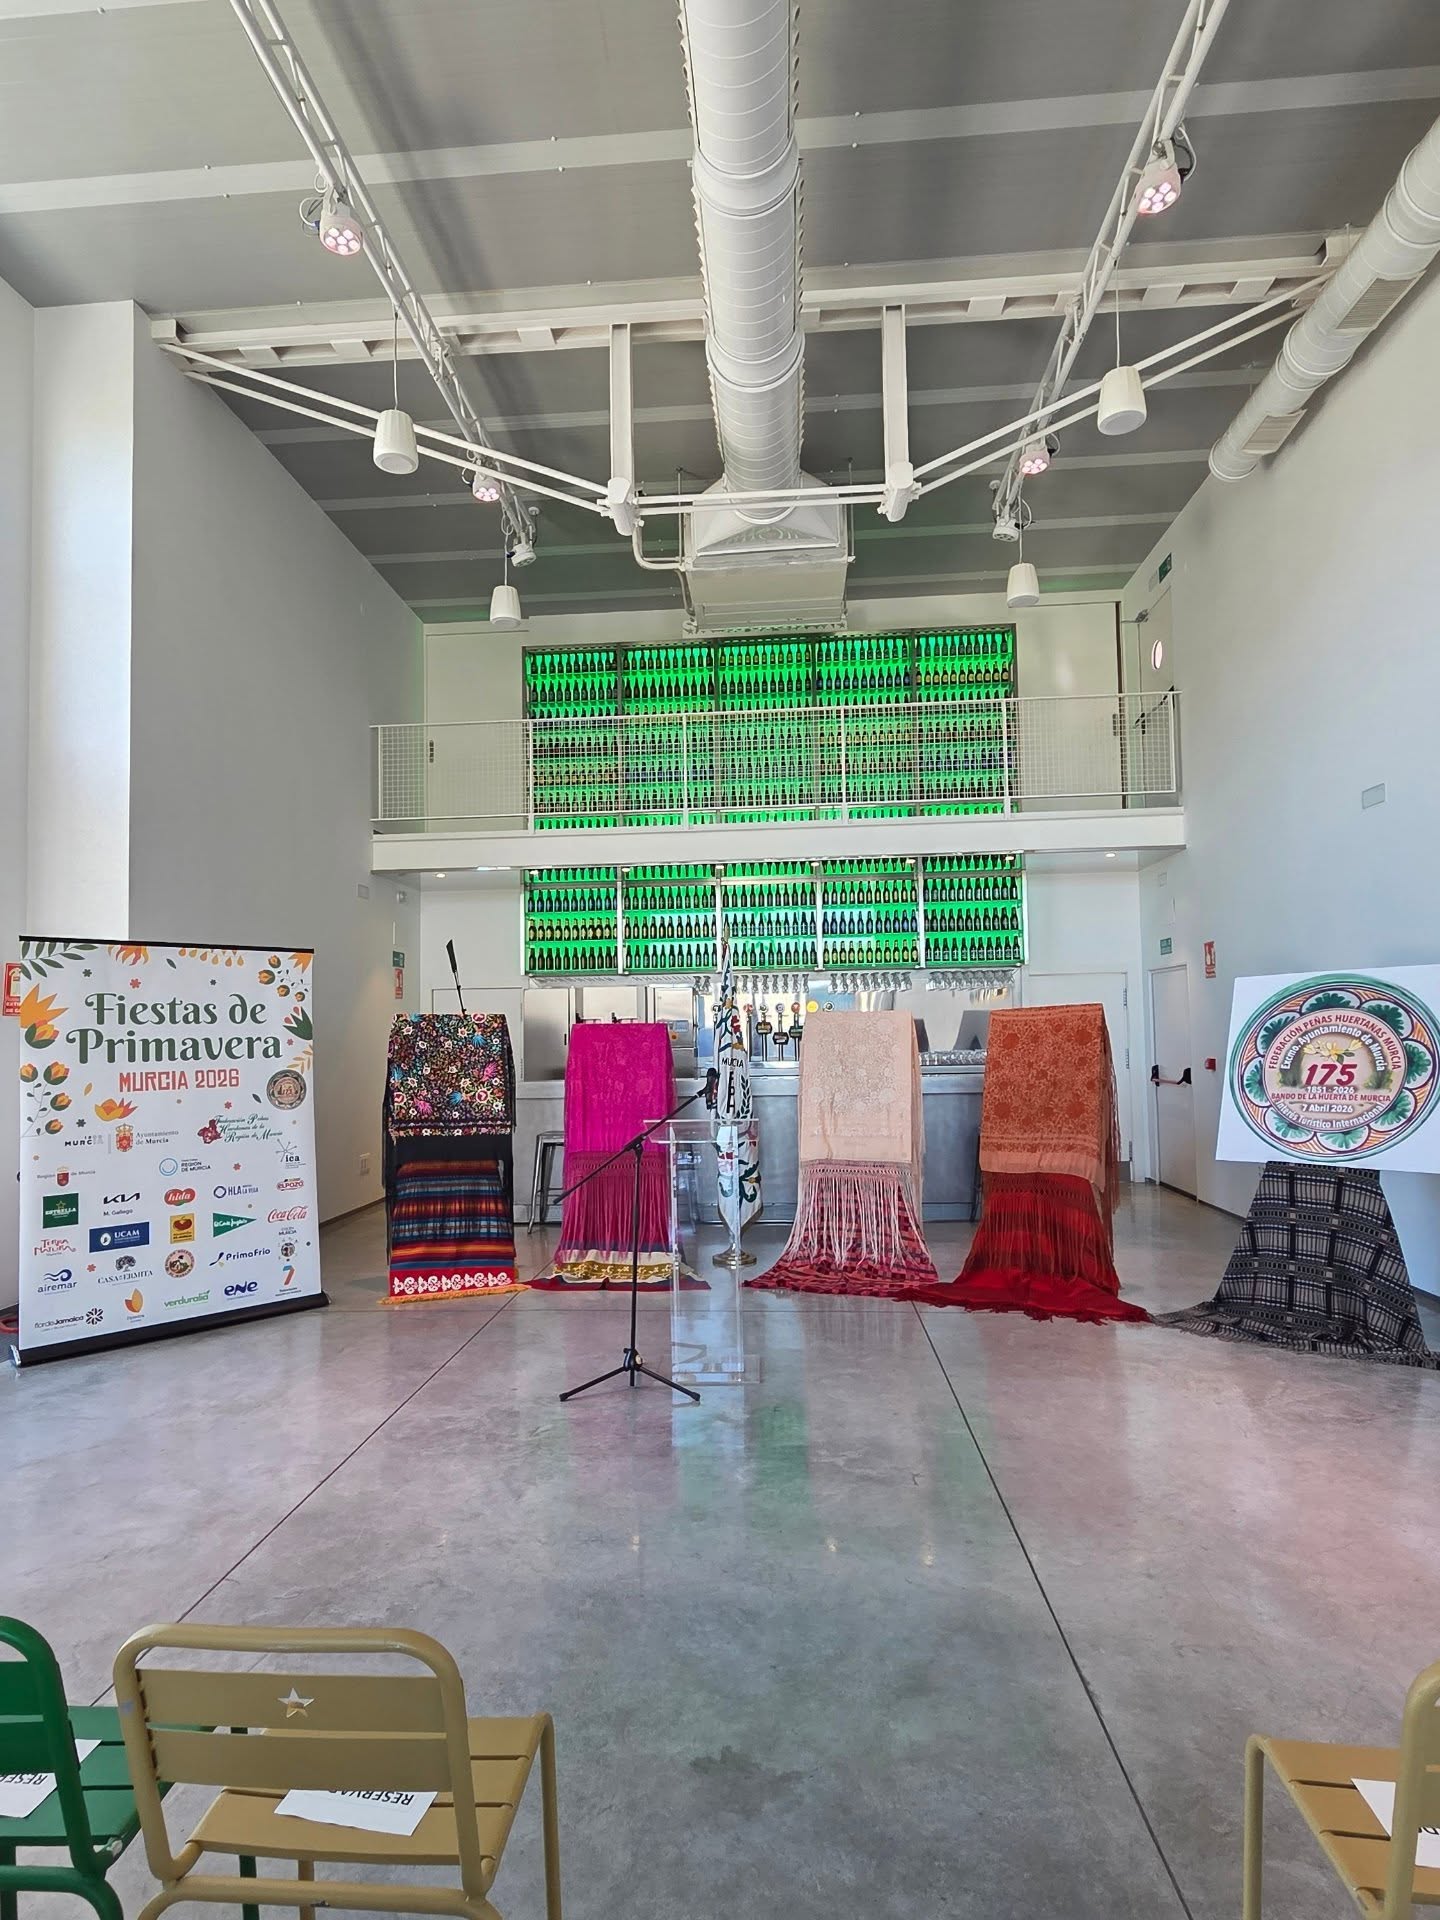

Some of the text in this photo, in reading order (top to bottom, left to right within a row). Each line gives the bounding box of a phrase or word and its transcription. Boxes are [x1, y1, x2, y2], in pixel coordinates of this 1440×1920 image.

[85, 993, 267, 1025] Fiestas de
[65, 1028, 283, 1064] Primavera
[1268, 1014, 1402, 1070] FEDERACIÓN PEÑAS HUERTANAS MURCIA
[1298, 1024, 1362, 1044] Ayuntamiento
[1360, 1034, 1373, 1046] de
[1369, 1042, 1388, 1072] Murcia
[119, 1069, 240, 1092] MURCIA 2026
[1305, 1063, 1358, 1086] 175
[1271, 1092, 1296, 1100] BANDO
[1318, 1093, 1347, 1101] HUERTA
[1360, 1094, 1391, 1102] MURCIA
[1307, 1086, 1327, 1094] 1851
[1333, 1086, 1355, 1094] 2026
[1302, 1103, 1354, 1113] 7 Abril 2026
[1332, 1101, 1387, 1129] Internacional
[136, 1130, 179, 1139] Ayuntamiento
[228, 1185, 242, 1196] HLA
[114, 1229, 140, 1239] UCAM
[37, 1281, 77, 1293] airemar
